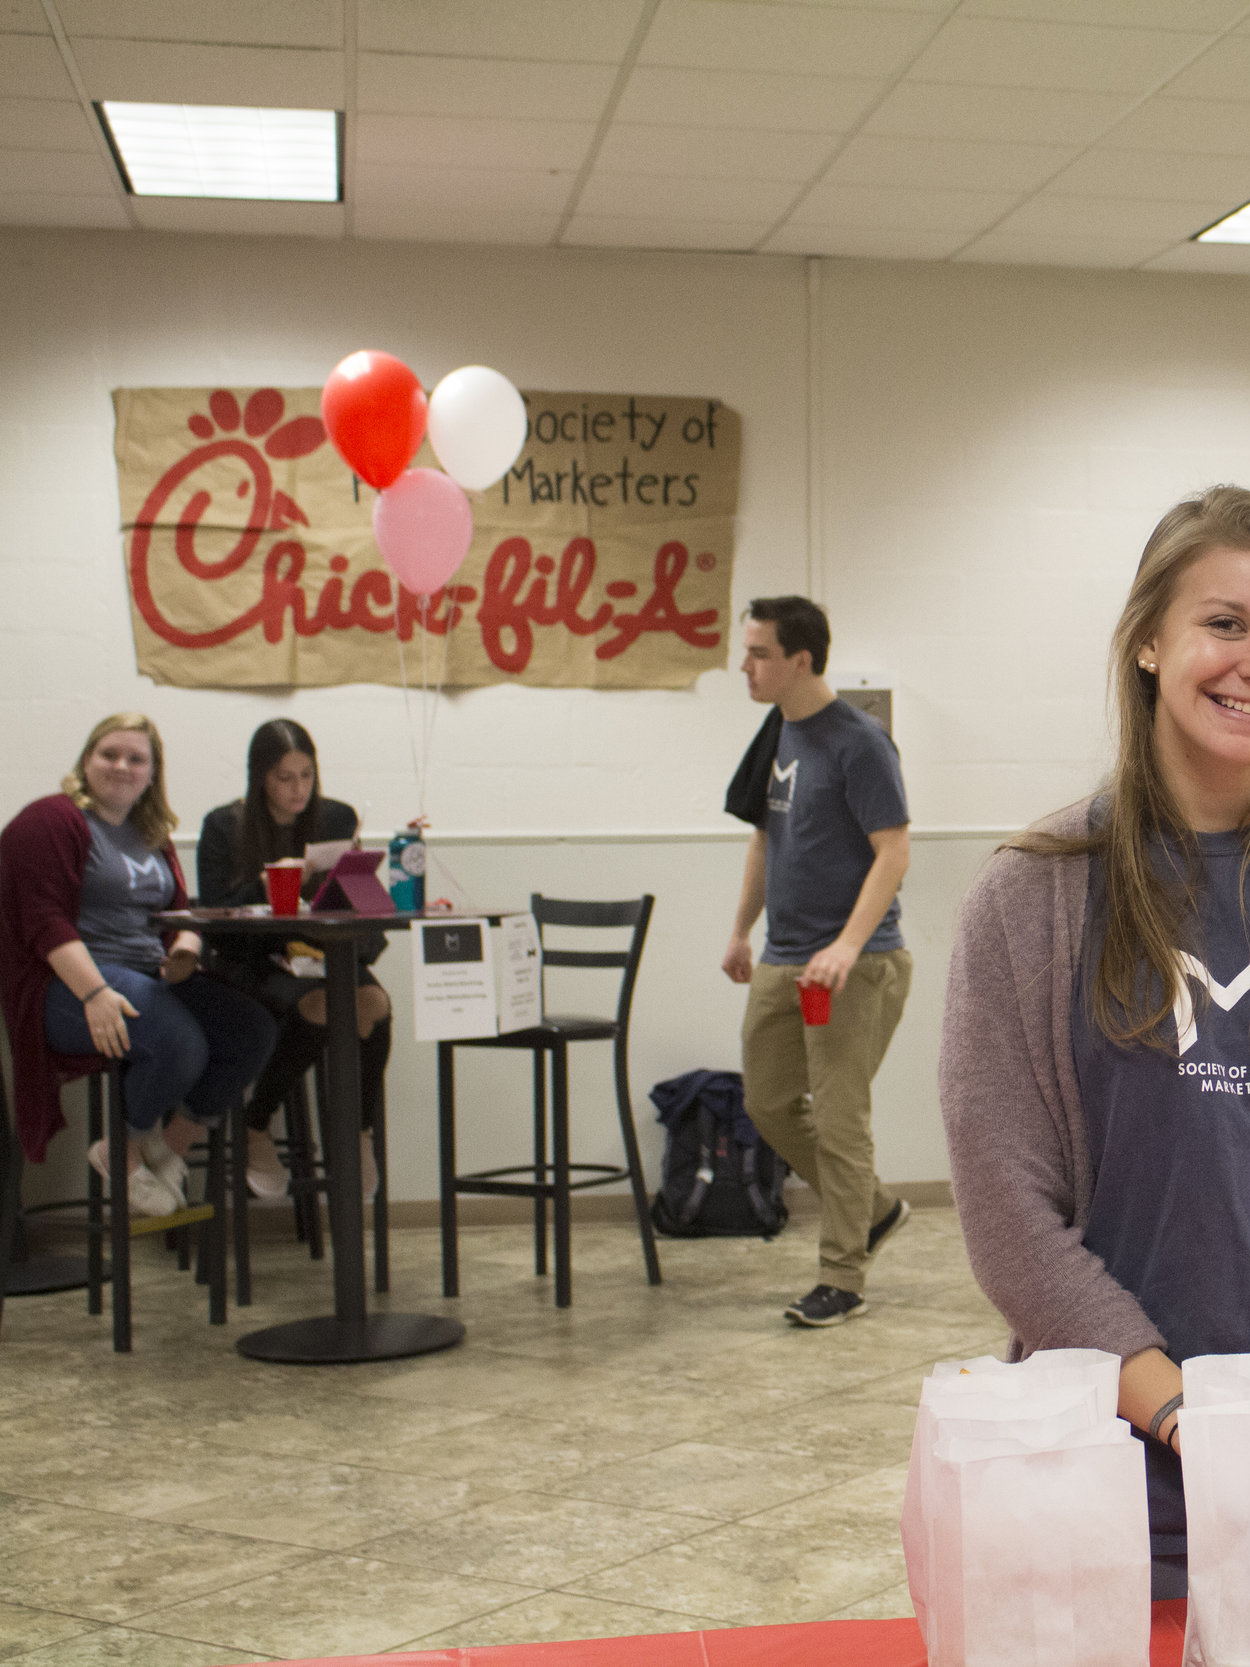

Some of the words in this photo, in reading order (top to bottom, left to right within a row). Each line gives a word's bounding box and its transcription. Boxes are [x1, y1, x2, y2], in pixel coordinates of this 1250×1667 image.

[524, 396, 667, 451] ociety
[502, 456, 699, 507] Marketers
[1178, 1062, 1226, 1077] SOCIETY
[1228, 1066, 1247, 1079] OF
